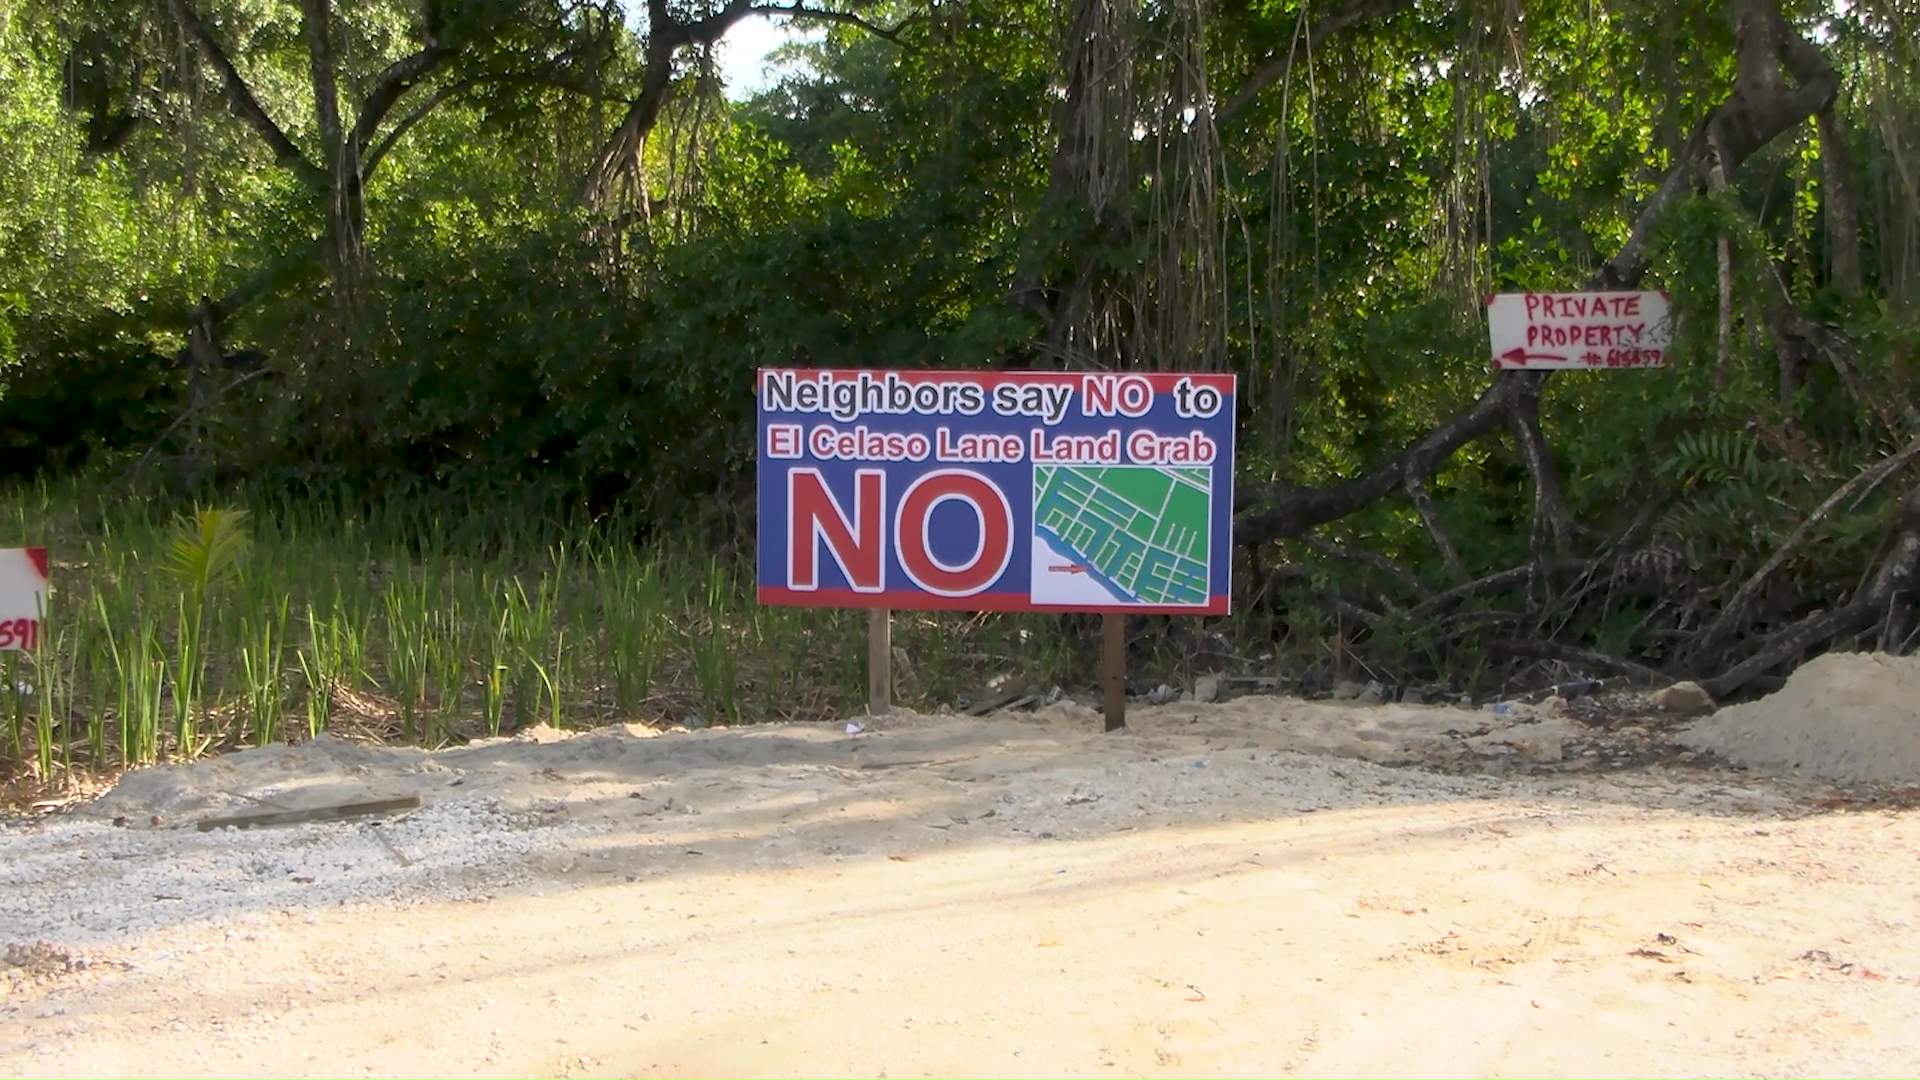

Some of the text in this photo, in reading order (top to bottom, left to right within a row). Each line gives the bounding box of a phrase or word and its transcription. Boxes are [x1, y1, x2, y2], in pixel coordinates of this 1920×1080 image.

[1524, 294, 1642, 321] PRIVATE
[1526, 323, 1645, 348] PROPERTY
[764, 372, 1222, 424] Neighbors say NO to
[768, 425, 1216, 465] El Celaso Lane Land Grab
[787, 467, 1015, 597] NO
